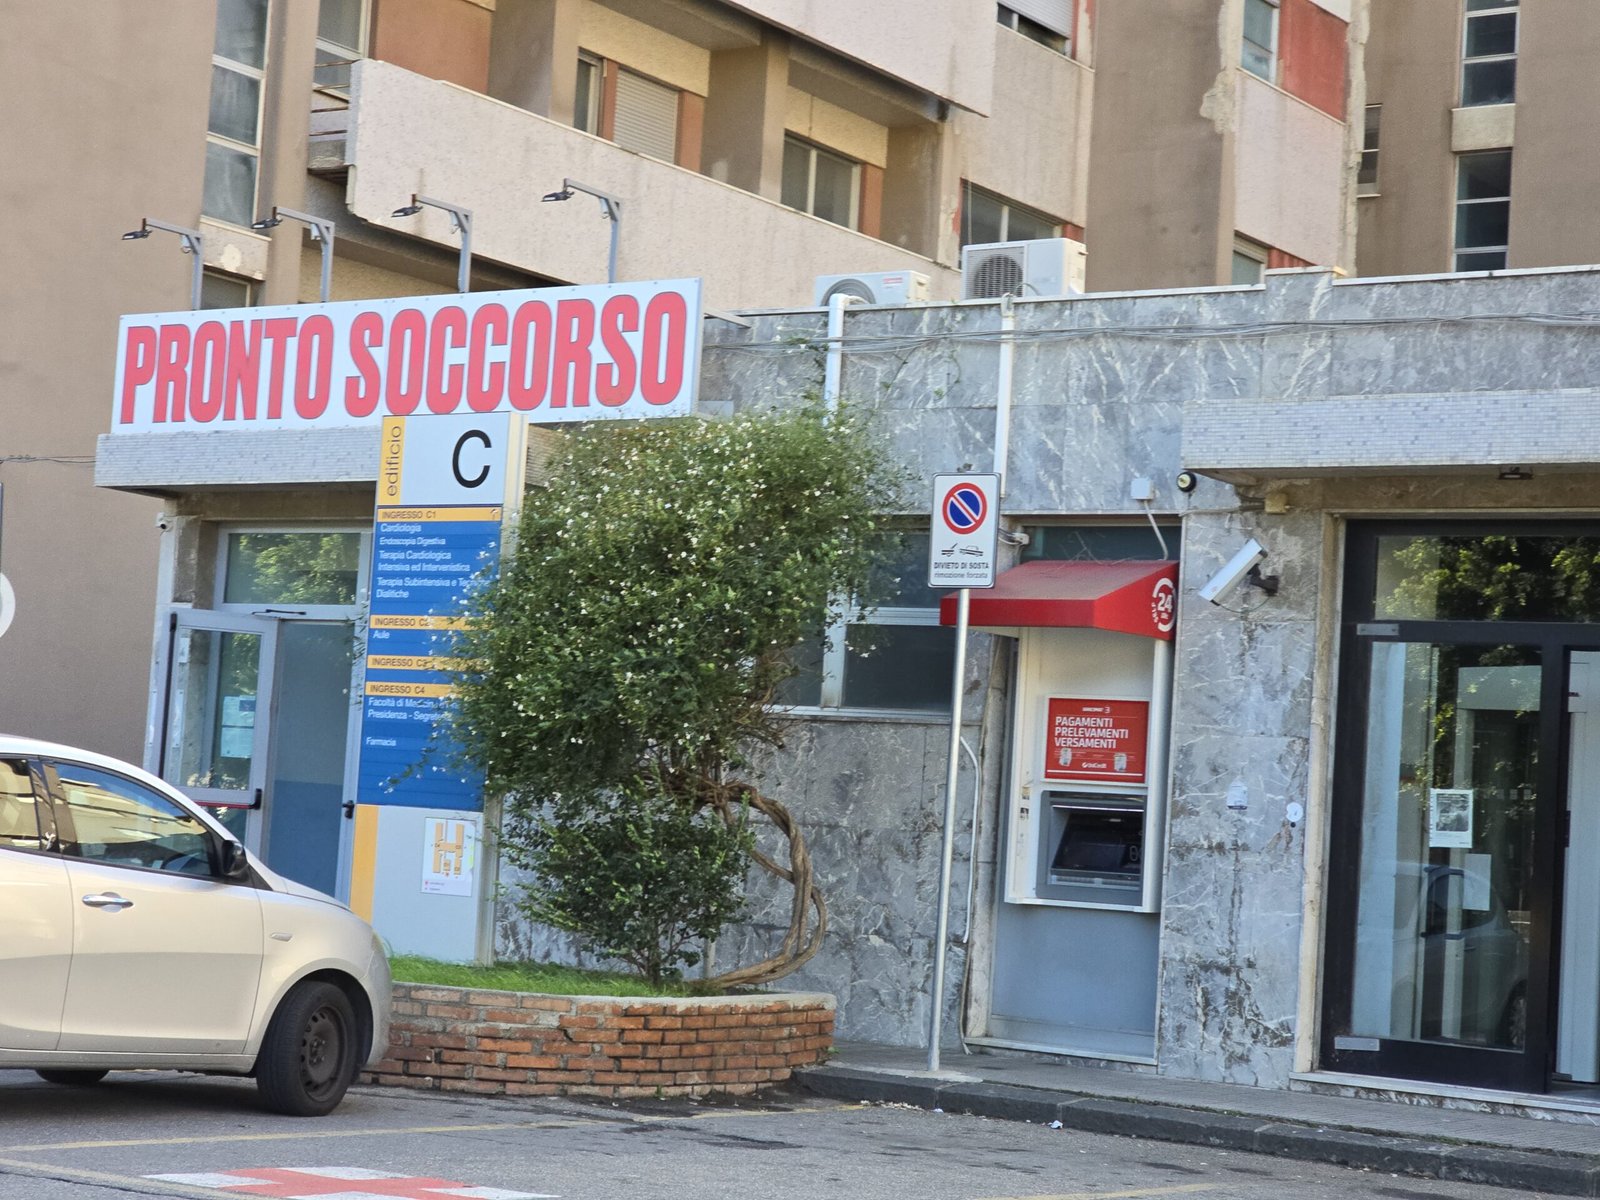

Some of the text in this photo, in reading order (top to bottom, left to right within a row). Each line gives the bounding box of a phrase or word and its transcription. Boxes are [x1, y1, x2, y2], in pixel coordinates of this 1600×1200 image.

[120, 291, 688, 424] PRONTO SOCCORSO
[385, 426, 402, 497] edificio
[452, 429, 492, 489] C
[382, 510, 437, 519] INGRESSO C1
[380, 523, 422, 534] Cardiologia
[379, 536, 447, 547] Endoscopia Digestiva
[379, 550, 452, 562] Terapia Cardiologica
[378, 563, 410, 572] Intensiva
[411, 563, 421, 572] ed
[934, 561, 960, 569] DIVIETO
[969, 562, 990, 570] SOSTA
[934, 571, 989, 579] rimozione forzata
[377, 577, 403, 588] Terapia
[404, 577, 451, 587] Subintensiva
[458, 577, 491, 587] Tecn
[1157, 592, 1173, 613] 24
[374, 617, 416, 627] INGRESSO
[372, 630, 390, 639] Aule
[371, 657, 413, 667] INGRESSO
[370, 684, 425, 695] INGRESSO C4
[368, 697, 395, 707] Facoltà
[395, 697, 404, 707] di
[405, 698, 437, 708] Mecin
[368, 709, 408, 719] Presidenza
[413, 711, 453, 722] Segret
[1055, 716, 1113, 728] PAGAMENTI
[1054, 727, 1129, 739] PRELEVAMENTI
[366, 737, 397, 747] Farmacia
[1054, 737, 1117, 749] VERSAMENTI
